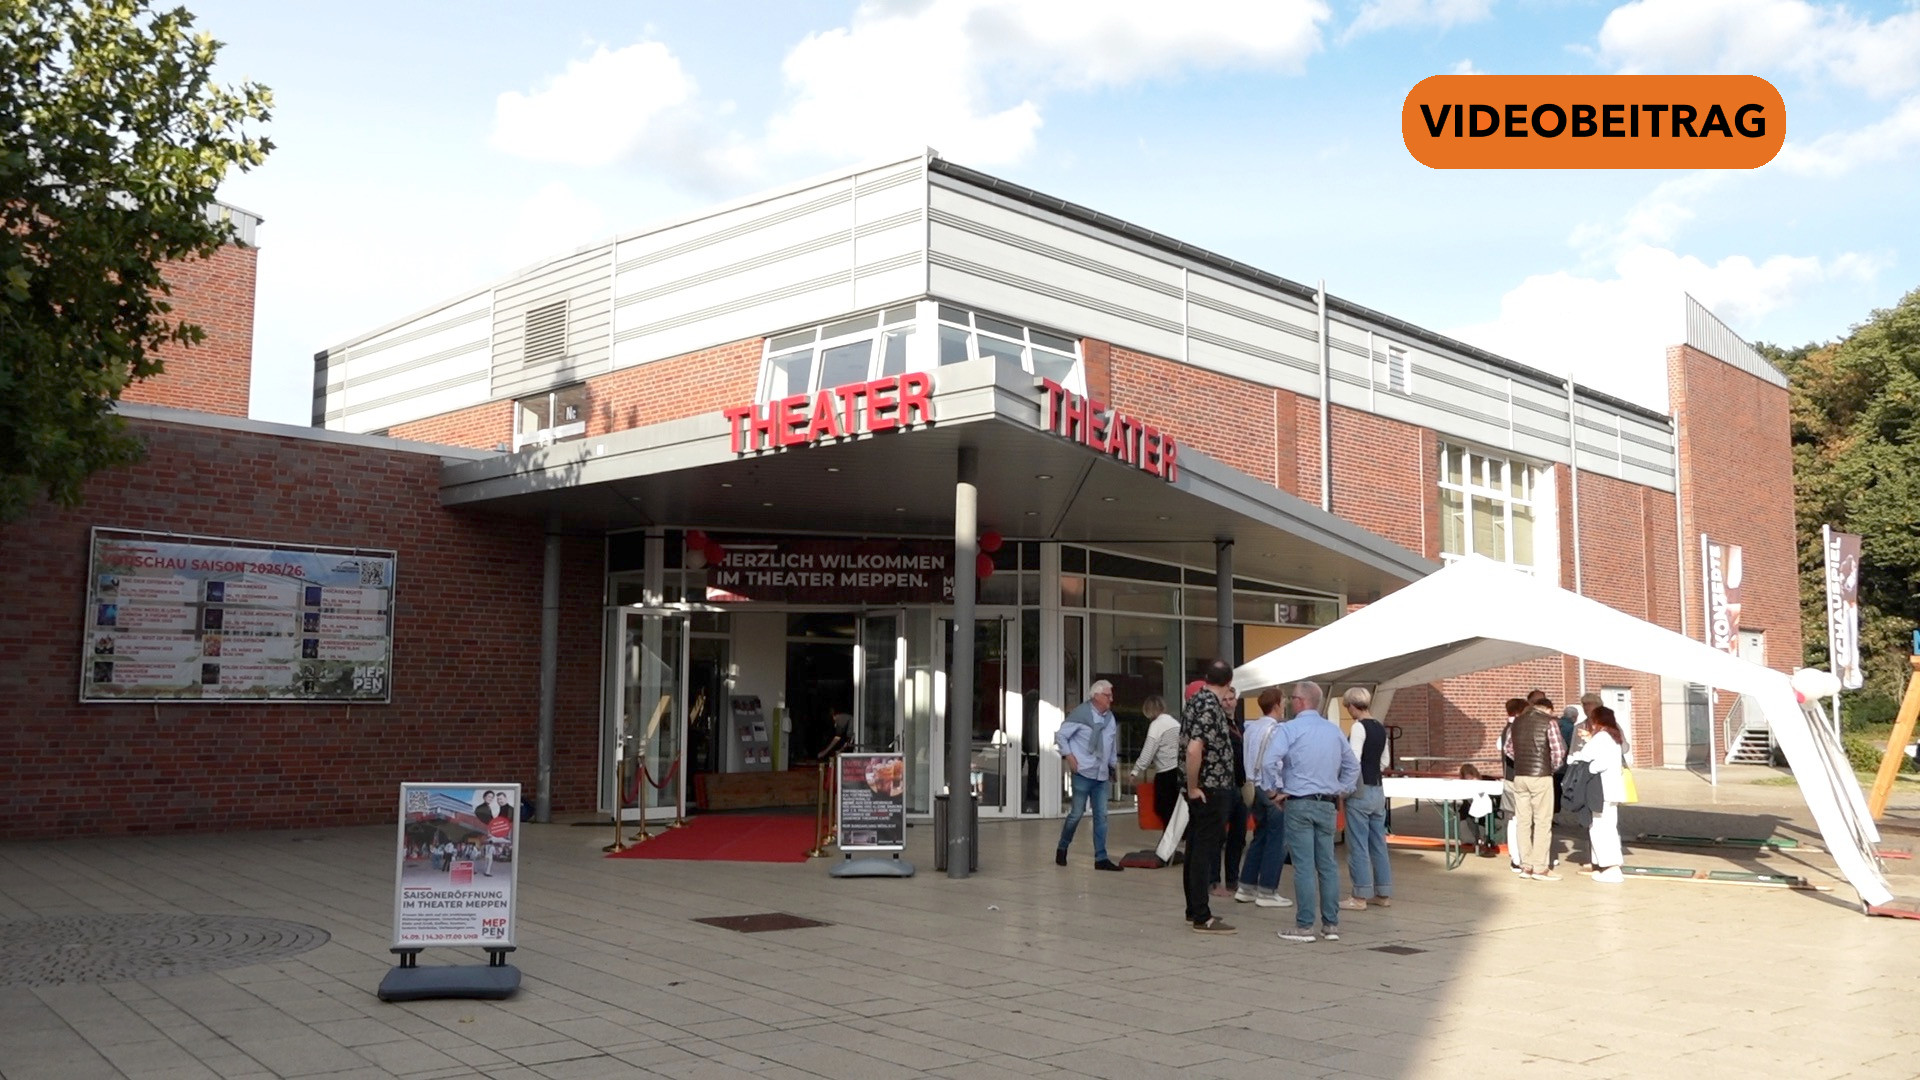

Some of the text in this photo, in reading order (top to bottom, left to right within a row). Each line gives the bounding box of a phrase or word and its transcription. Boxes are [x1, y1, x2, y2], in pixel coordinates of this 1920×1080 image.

[723, 371, 935, 454] THEATER
[1037, 377, 1178, 484] THEATER
[191, 558, 244, 574] SAISON
[249, 562, 306, 578] 2025/26.
[718, 552, 945, 570] HERZLICH WILKOMMEN
[716, 570, 740, 586] IM
[744, 571, 834, 587] THEATER
[840, 572, 929, 587] MEPPEN.
[1709, 544, 1730, 649] KONZERTE
[1830, 536, 1851, 668] SCHAUSPIEL
[354, 666, 385, 679] MEP
[353, 678, 382, 691] PEN
[404, 890, 502, 899] SAISONERÖFFNUNG
[483, 918, 507, 927] MEP
[482, 927, 504, 936] PEN
